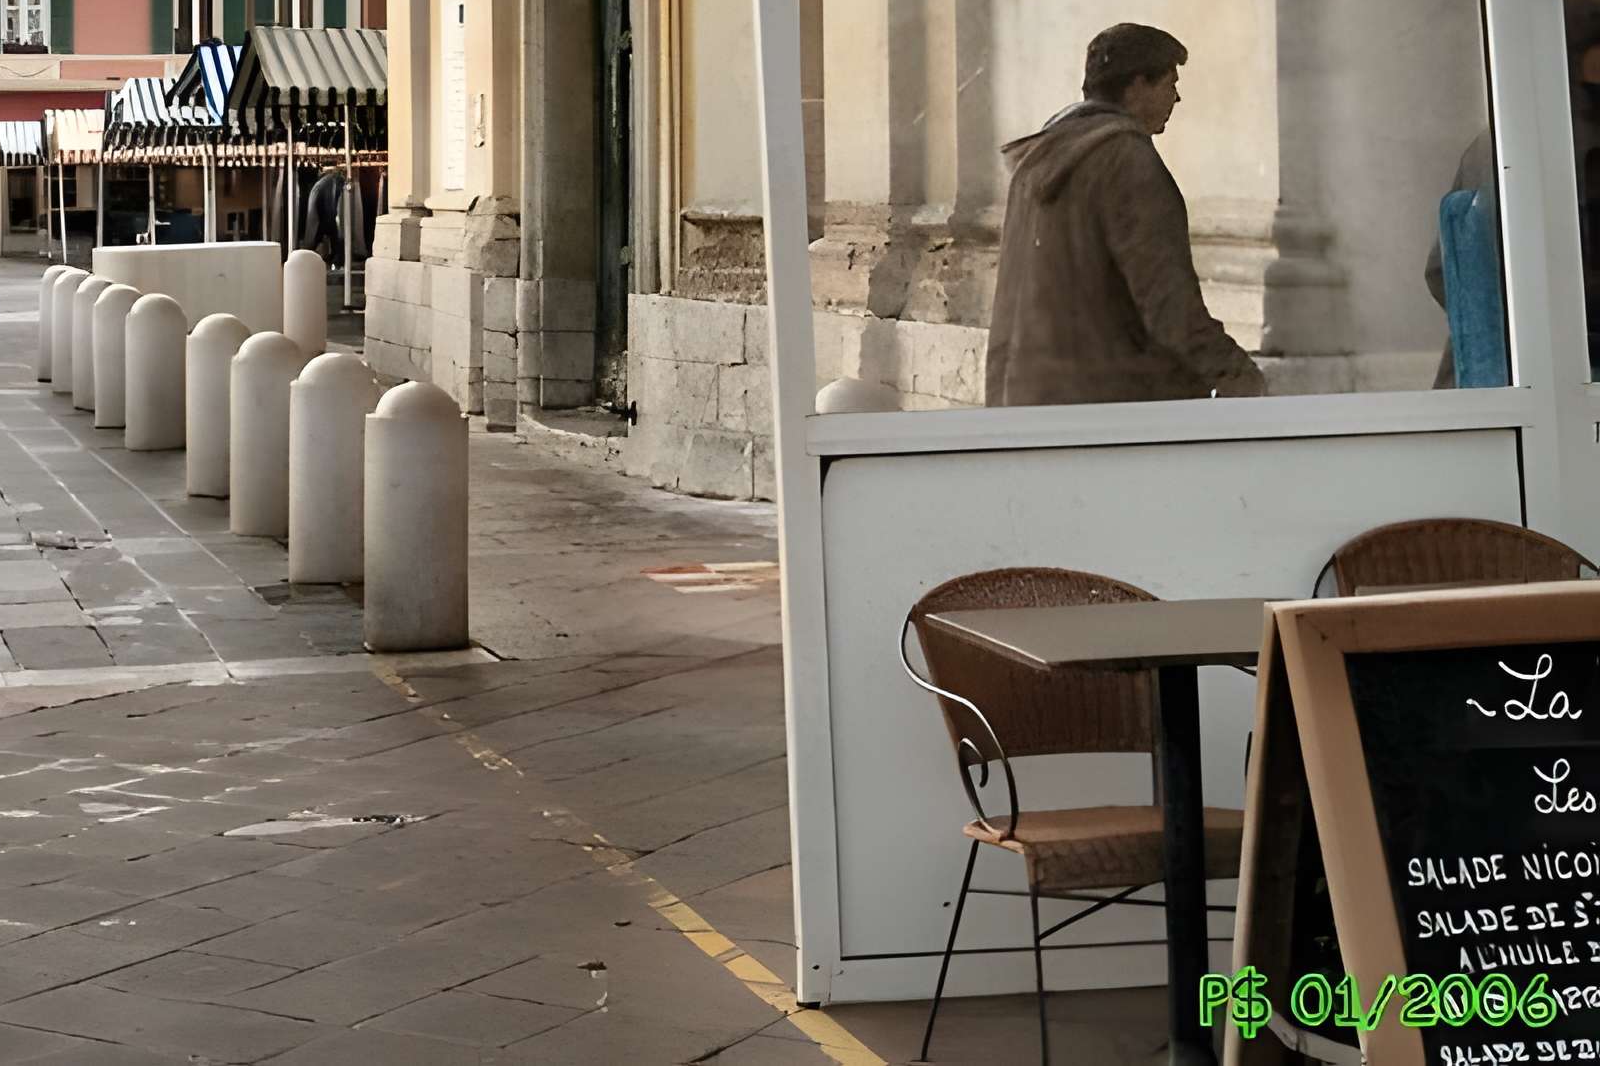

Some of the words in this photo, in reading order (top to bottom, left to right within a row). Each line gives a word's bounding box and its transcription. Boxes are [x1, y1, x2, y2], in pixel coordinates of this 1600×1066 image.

[1498, 653, 1583, 721] La
[1533, 758, 1597, 814] Les
[1408, 854, 1507, 891] SALADE
[1417, 904, 1519, 939] SALADE
[1526, 901, 1566, 931] DE
